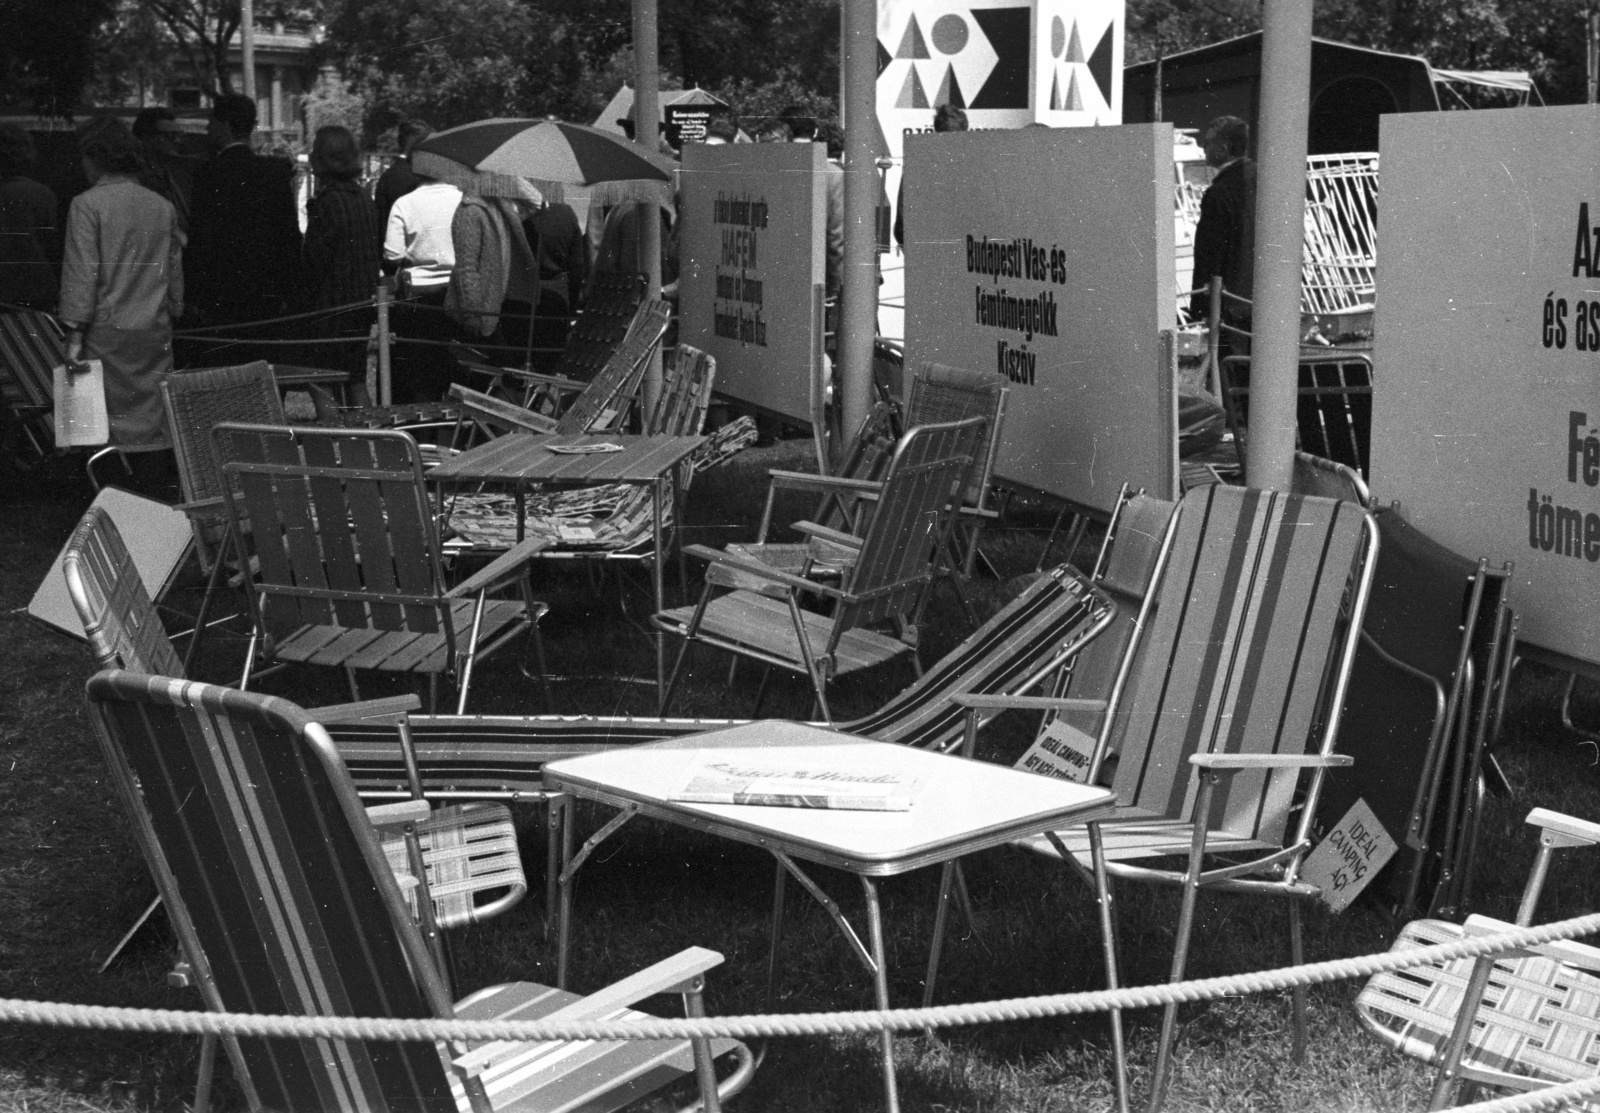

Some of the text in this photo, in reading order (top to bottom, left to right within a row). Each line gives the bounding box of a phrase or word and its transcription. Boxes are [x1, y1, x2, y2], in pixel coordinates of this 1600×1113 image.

[966, 234, 1021, 284] Budapesti
[976, 285, 1058, 342] Fémtömegcikk
[1543, 290, 1568, 349] és
[997, 341, 1036, 386] Kiszöv
[1568, 411, 1600, 487] Fé
[1527, 488, 1600, 563] töme
[1040, 735, 1062, 755] IDEÁL
[1329, 829, 1368, 883] CAMPING
[1348, 820, 1381, 861] IDEÁL
